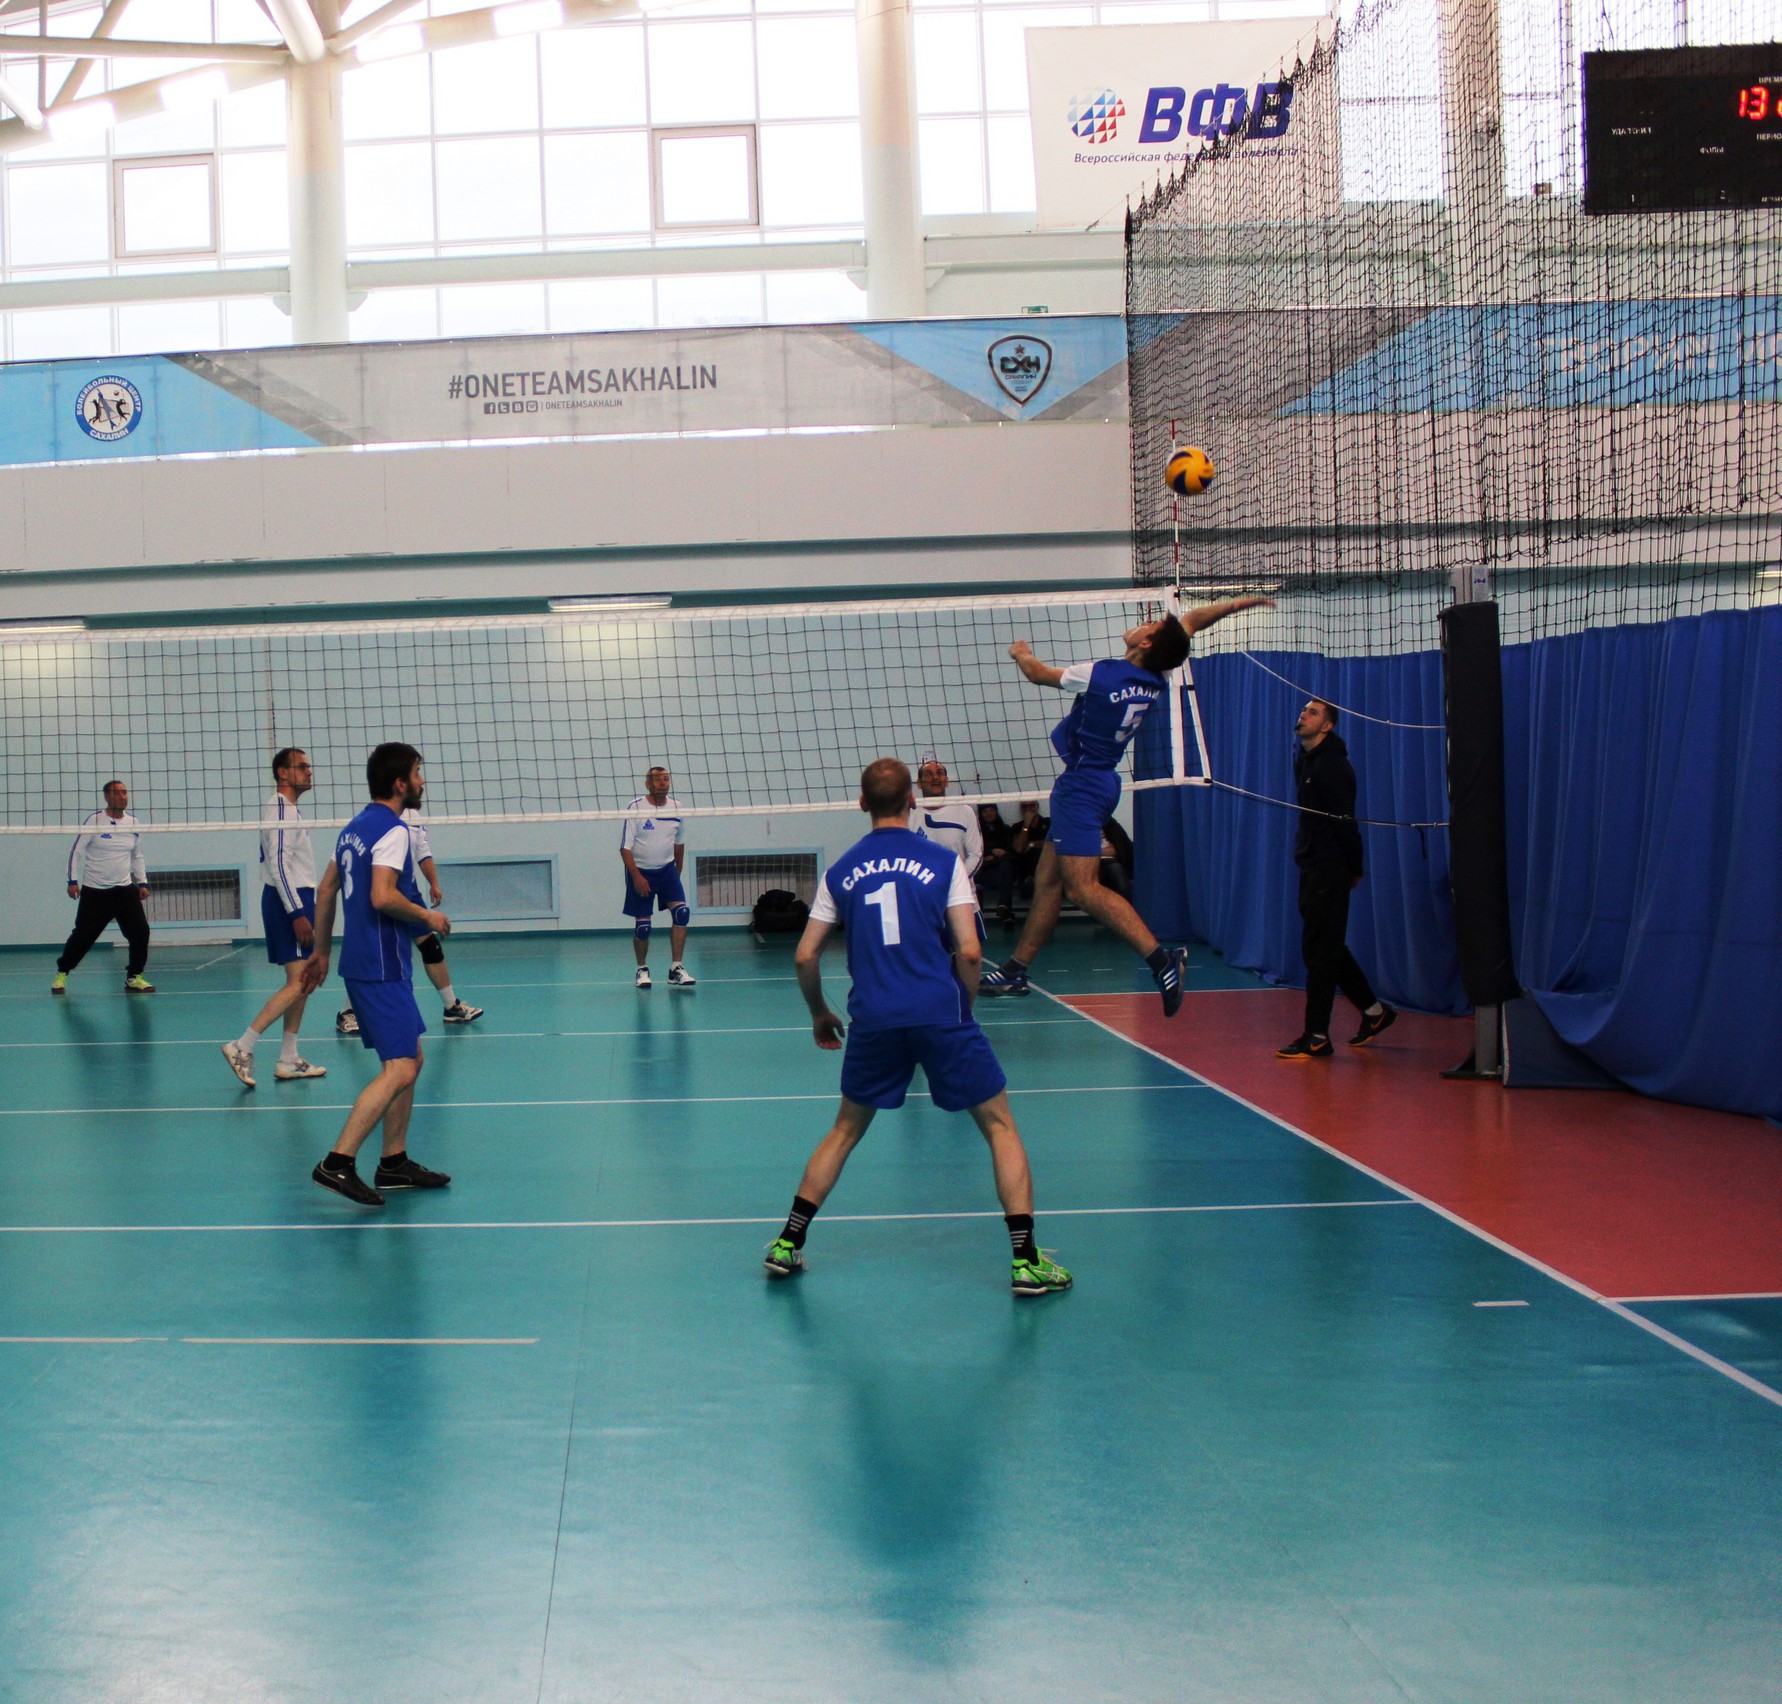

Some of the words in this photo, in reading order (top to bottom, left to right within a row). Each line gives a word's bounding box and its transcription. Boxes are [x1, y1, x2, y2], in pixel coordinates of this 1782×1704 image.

[1138, 83, 1293, 143] ВФВ
[1756, 133, 1782, 141] ПЕРИО
[1074, 152, 1160, 163] Всероссийская
[127, 385, 142, 412] ЦЕНТР
[448, 365, 718, 399] #ONETEAMSAKHALIN
[545, 399, 623, 410] ONETEAMSAKHALIN
[89, 428, 129, 440] САХАЛИН
[1115, 703, 1150, 742] 5
[341, 849, 353, 900] 3
[842, 857, 936, 891] САХАЛИН
[864, 881, 900, 946] 1
